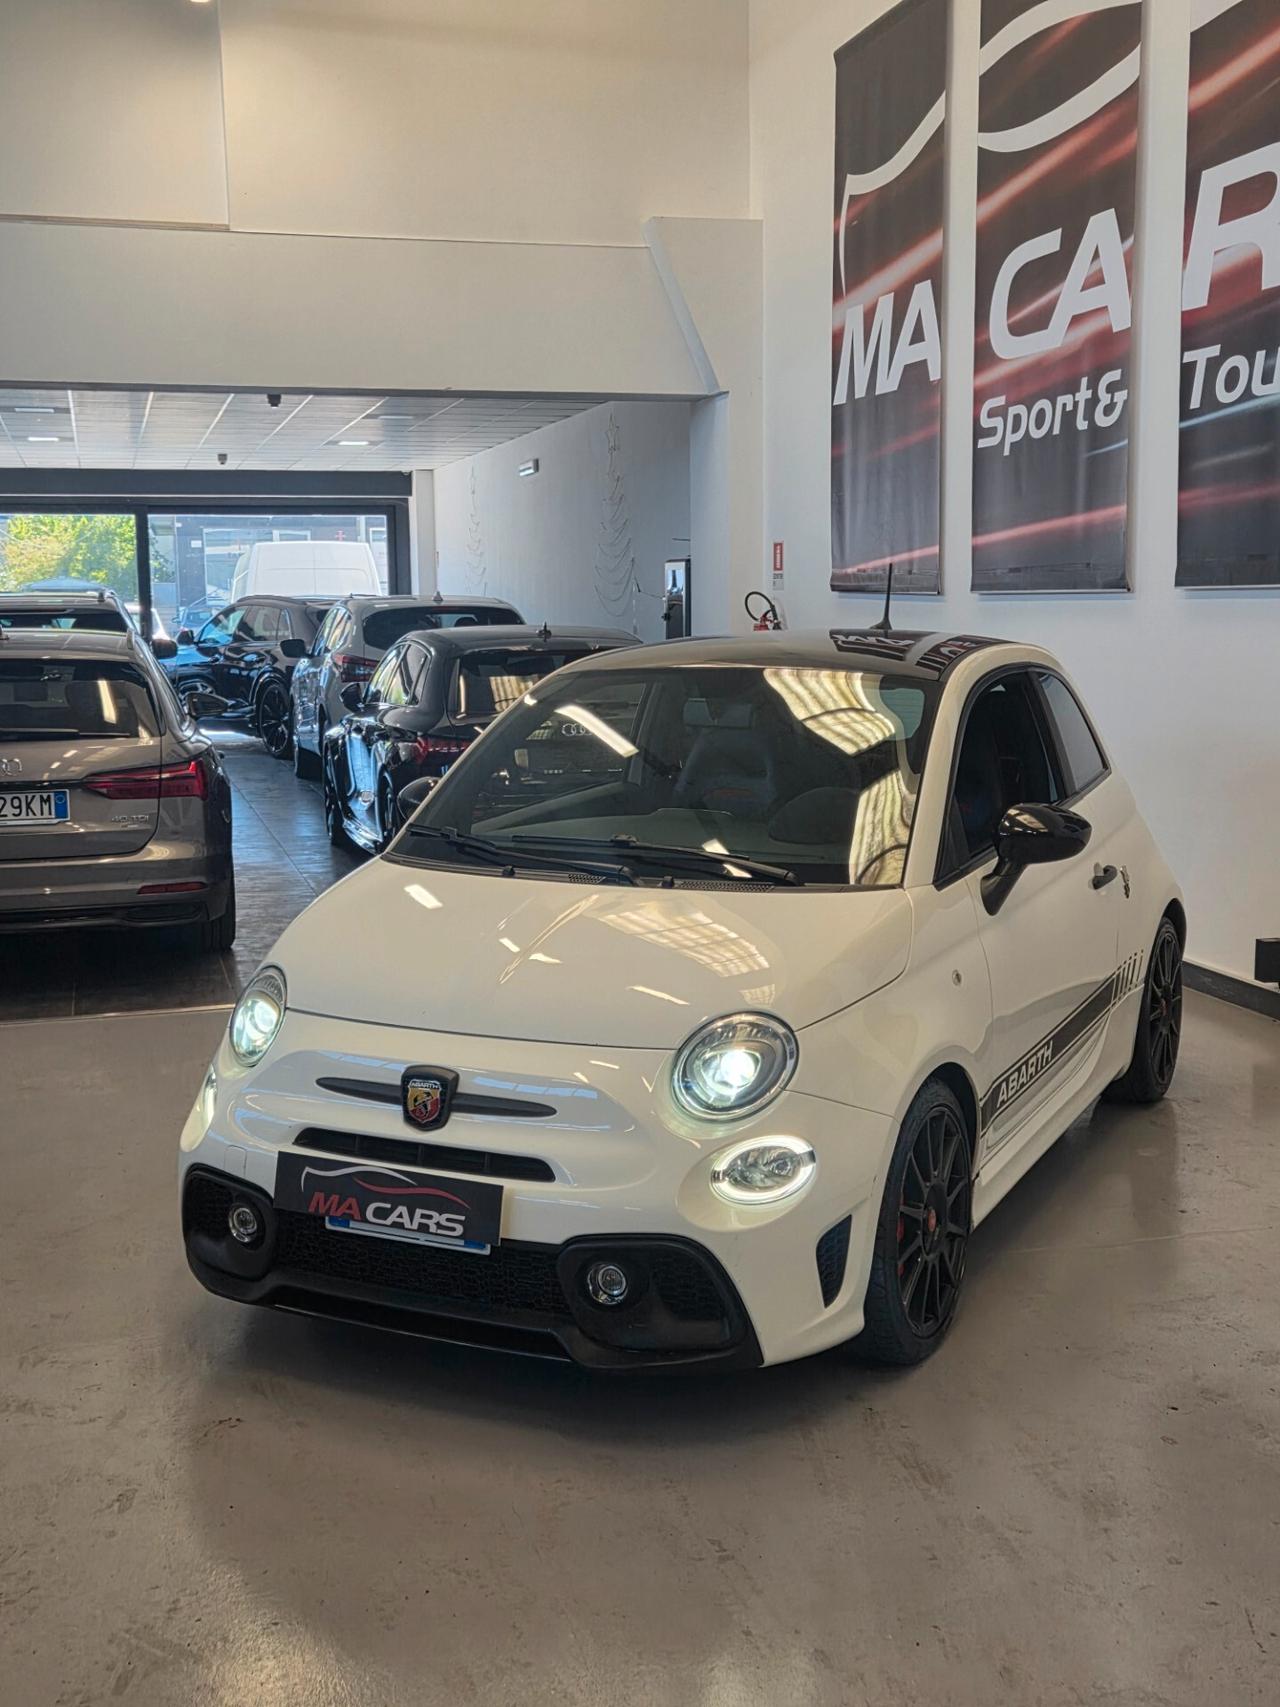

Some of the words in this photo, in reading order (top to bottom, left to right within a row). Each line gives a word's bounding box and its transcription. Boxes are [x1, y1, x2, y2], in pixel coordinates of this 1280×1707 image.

[833, 279, 942, 405] MA
[411, 1081, 439, 1089] ABARTH
[995, 1039, 1053, 1108] ABARTH
[308, 1191, 362, 1221] MA
[365, 1202, 466, 1237] CARS
